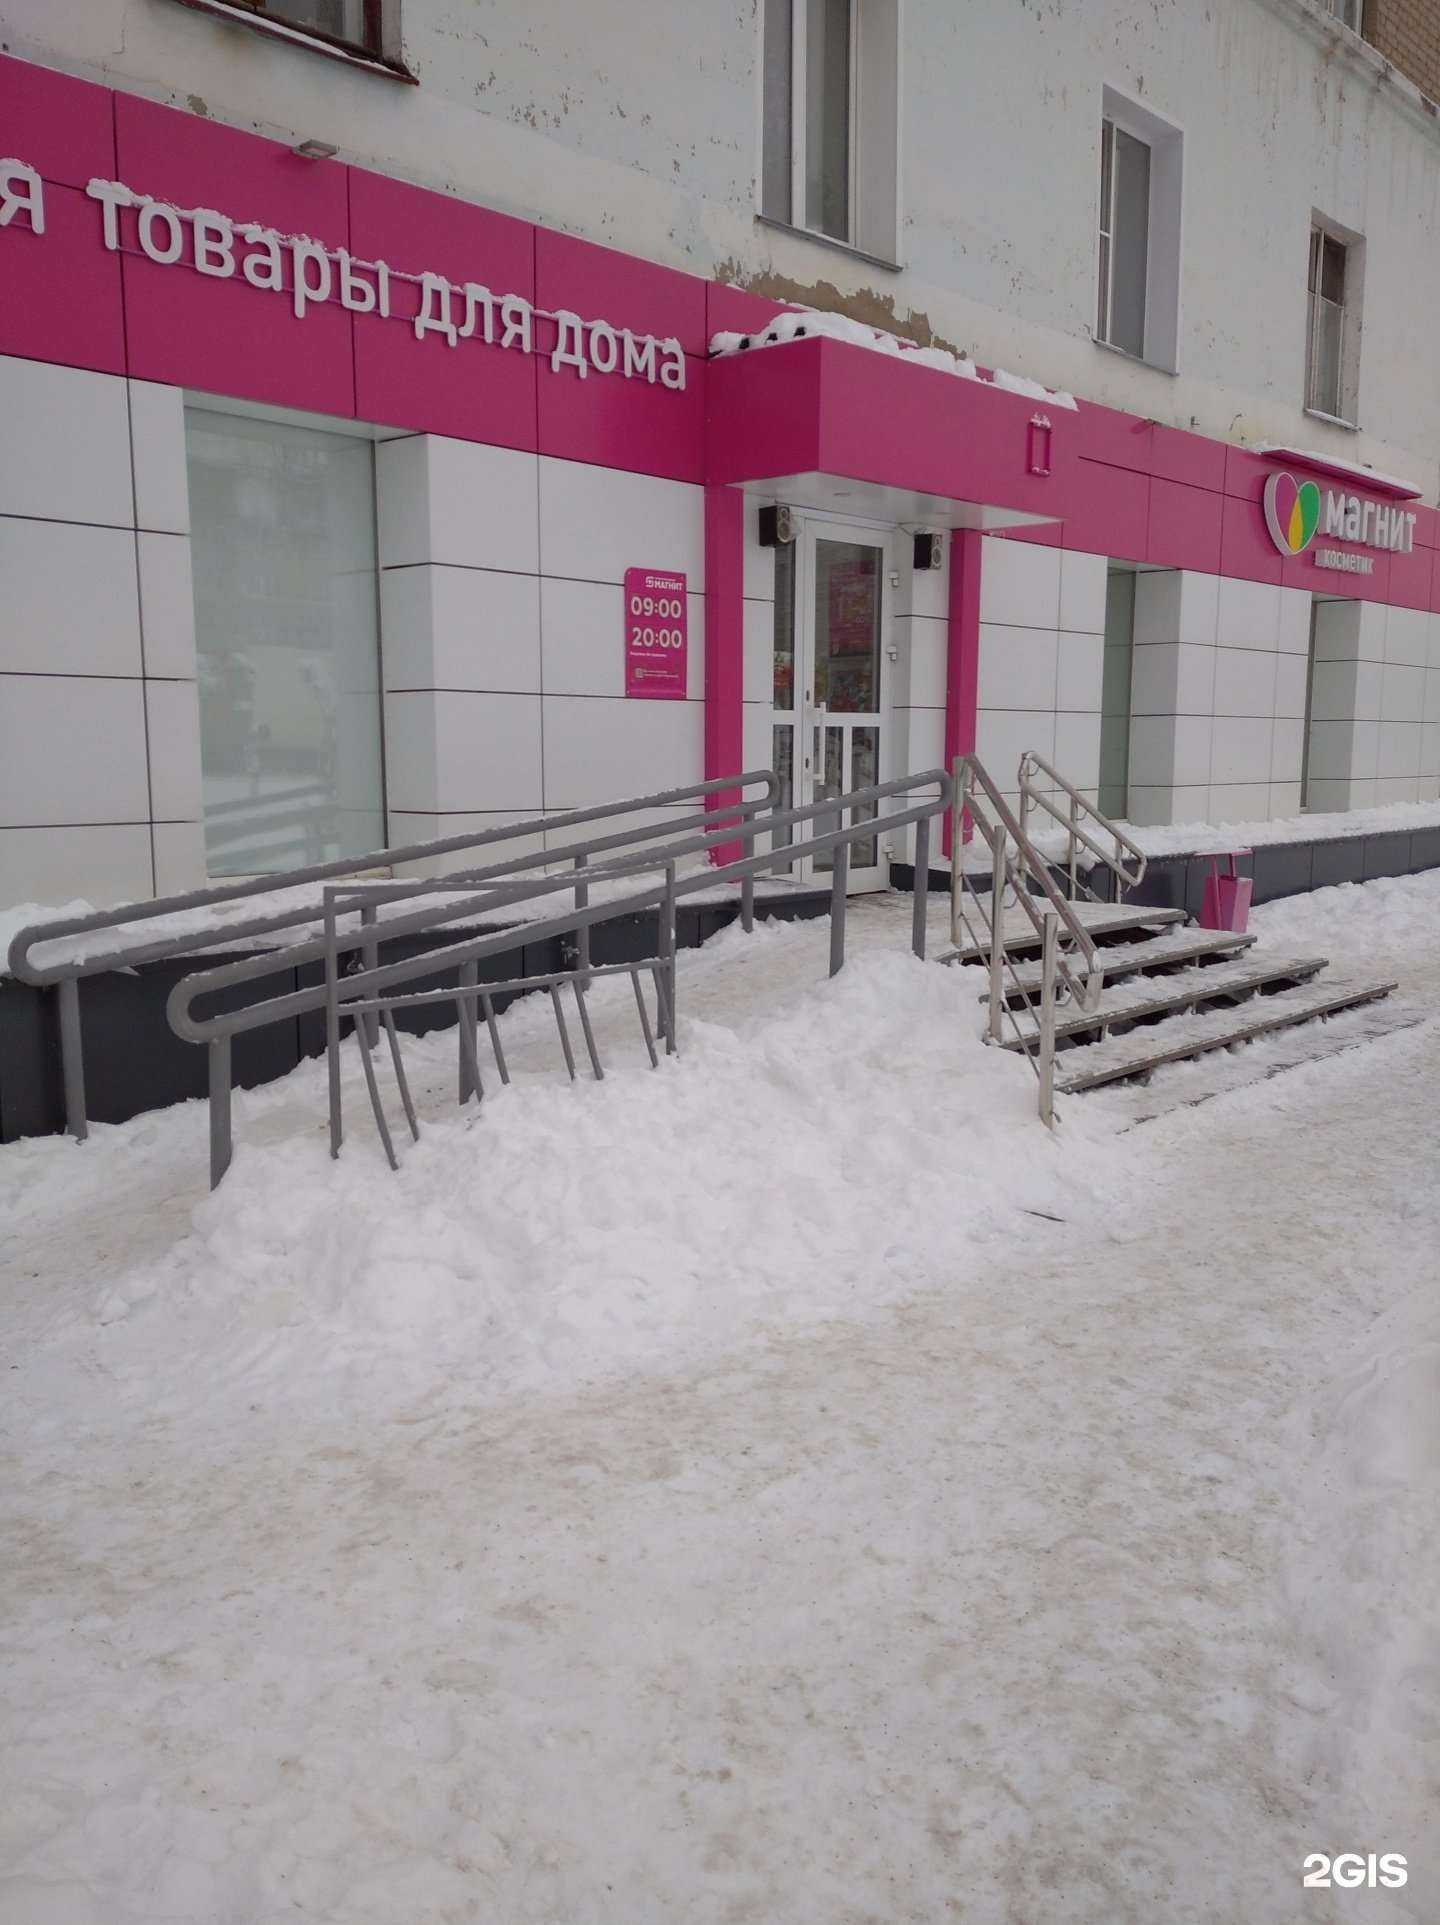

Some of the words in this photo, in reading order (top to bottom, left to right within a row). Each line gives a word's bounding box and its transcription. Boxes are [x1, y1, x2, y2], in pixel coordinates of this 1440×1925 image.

[86, 179, 390, 318] товары
[415, 273, 532, 353] для
[551, 310, 686, 391] дома
[631, 596, 681, 618] 09:00
[632, 627, 682, 648] 20:00
